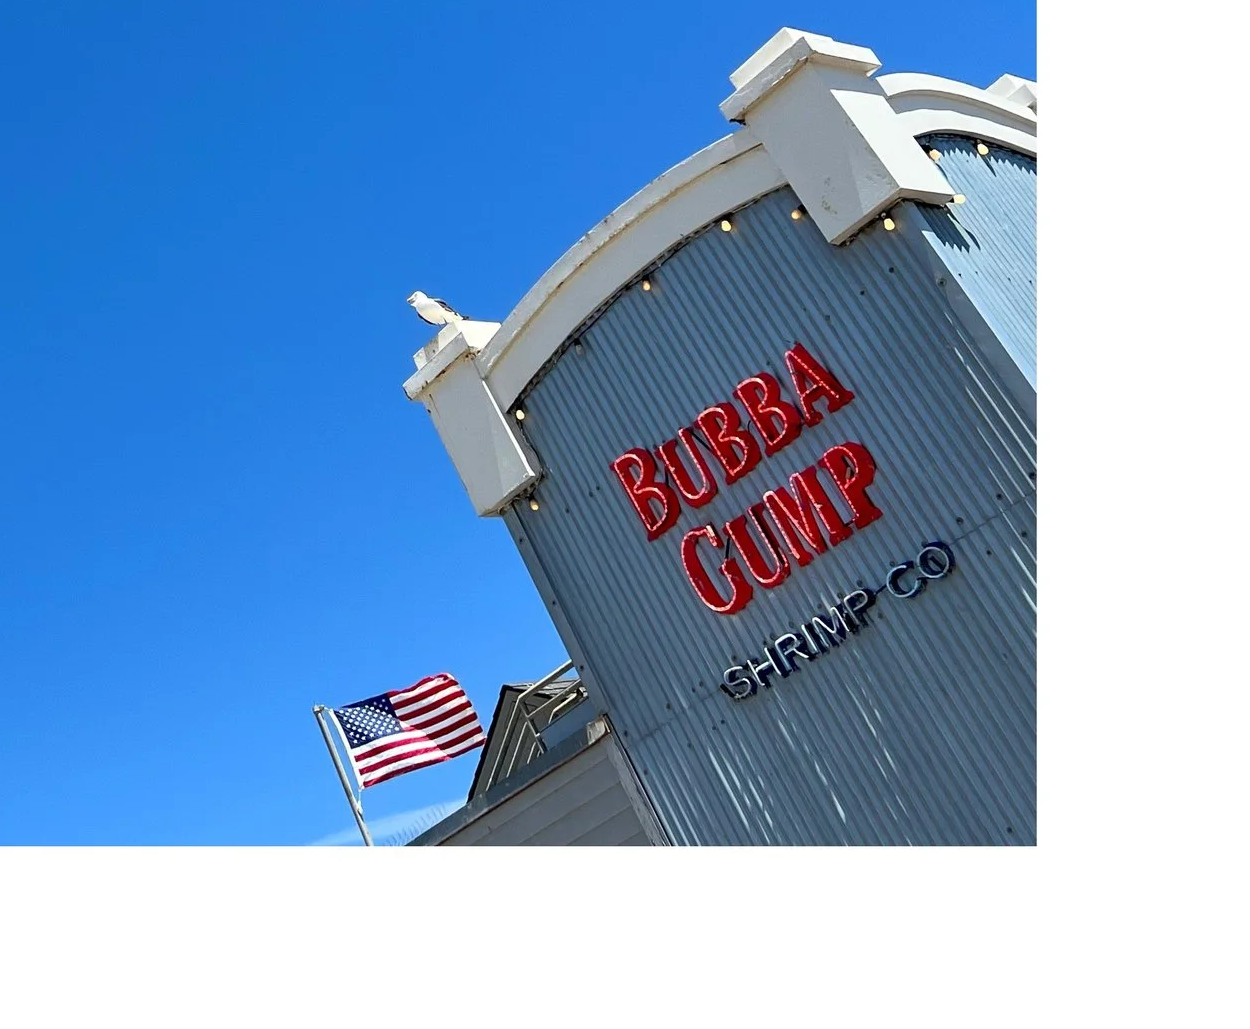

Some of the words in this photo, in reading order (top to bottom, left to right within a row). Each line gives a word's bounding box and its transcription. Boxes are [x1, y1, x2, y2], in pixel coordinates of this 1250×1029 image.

[610, 341, 854, 541] BUBBA
[680, 442, 883, 615] GUMP
[720, 587, 877, 700] SHRIMP
[886, 540, 956, 599] CO
